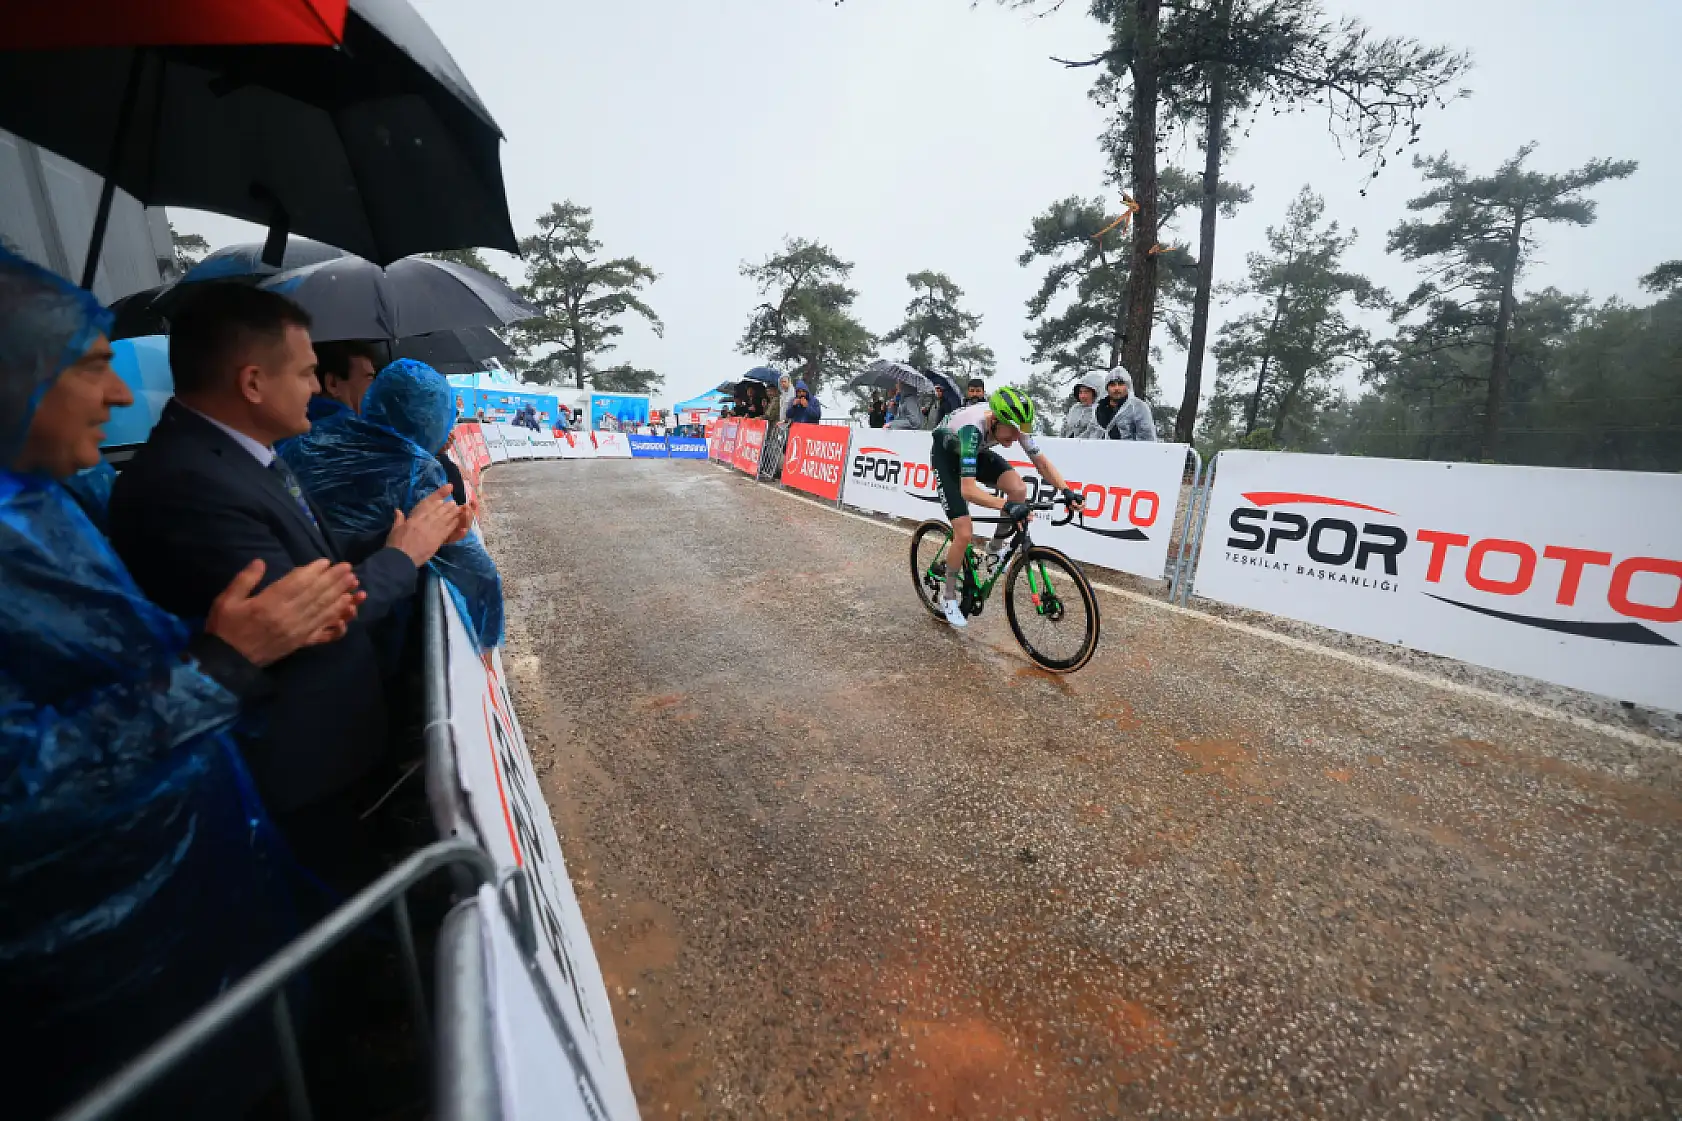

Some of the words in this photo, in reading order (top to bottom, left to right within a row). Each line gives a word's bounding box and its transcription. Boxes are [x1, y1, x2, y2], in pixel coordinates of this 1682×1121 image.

[806, 439, 843, 461] TURKISH
[800, 459, 839, 484] AIRLINES
[853, 455, 901, 484] SPOR
[1227, 506, 1408, 576] SPOR
[1416, 529, 1682, 624] TOTO
